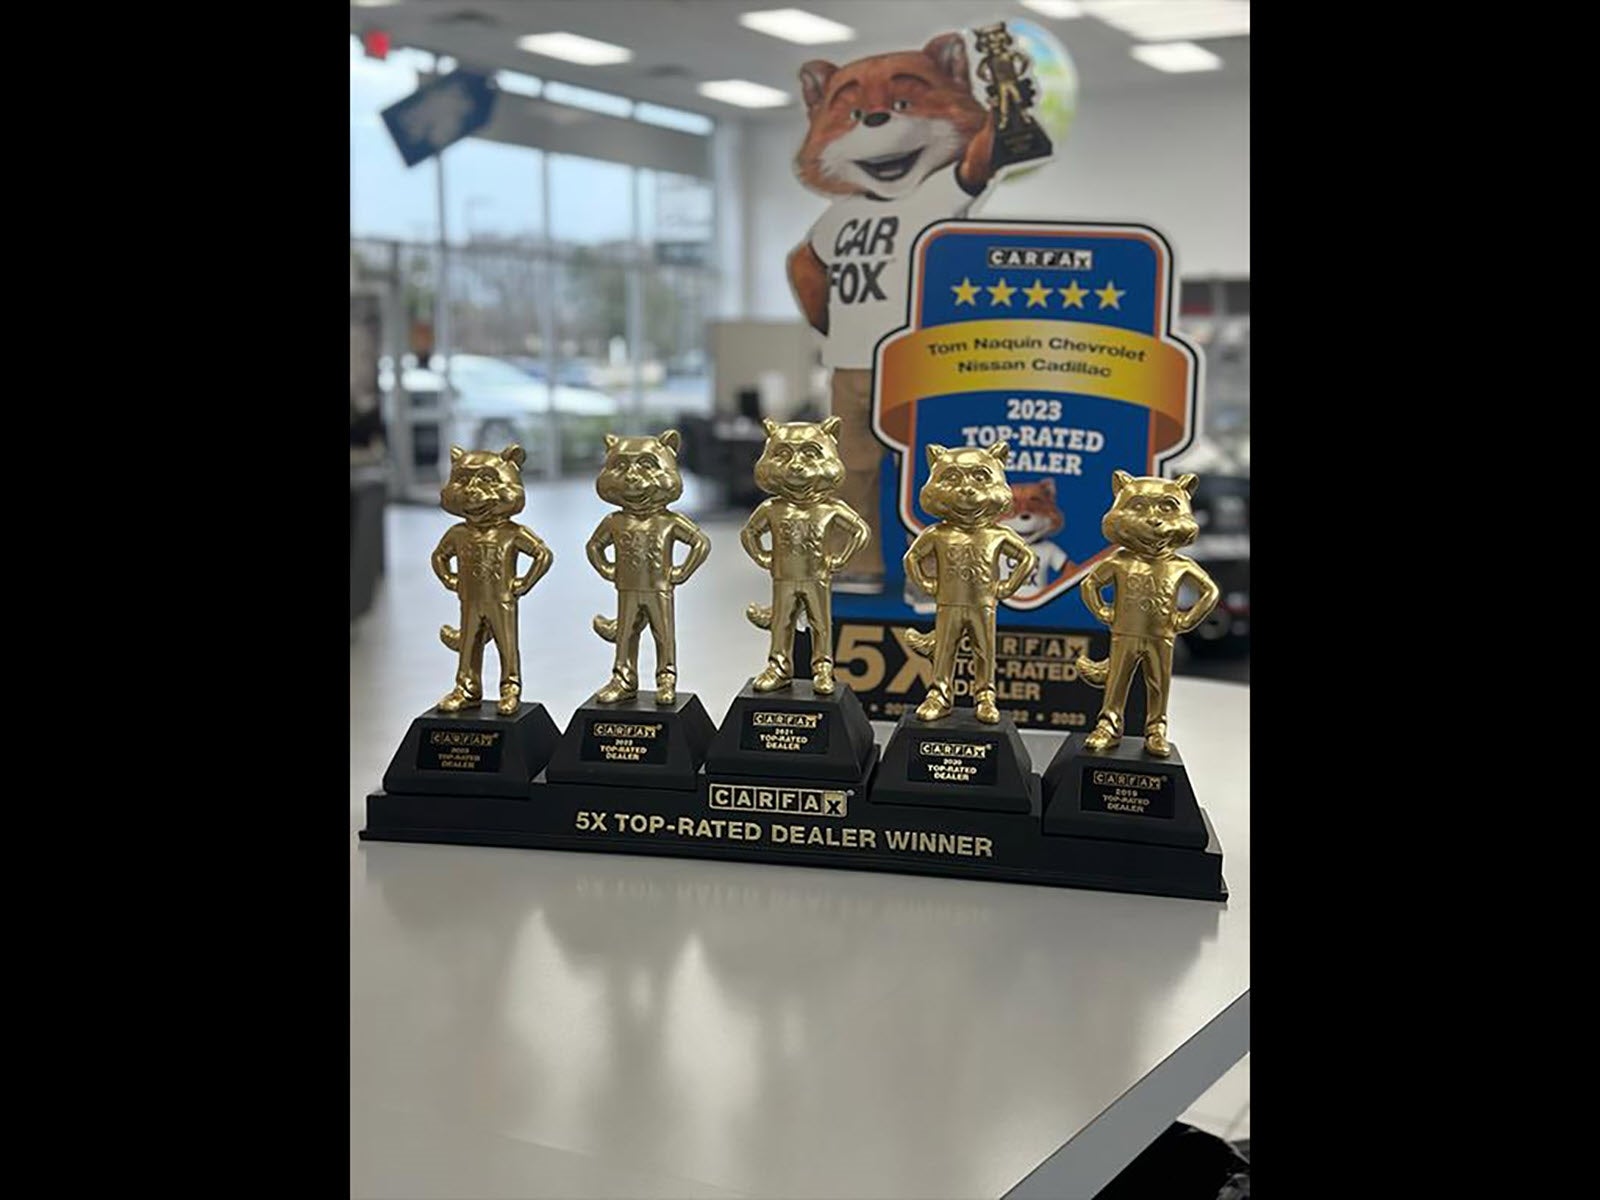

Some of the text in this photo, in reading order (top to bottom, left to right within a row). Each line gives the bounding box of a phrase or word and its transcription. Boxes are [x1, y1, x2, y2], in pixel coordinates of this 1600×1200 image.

[834, 216, 899, 256] CAR
[989, 247, 1092, 270] CARFAX
[831, 261, 887, 304] FOX
[928, 336, 1146, 362] Tom Naquin Chevrolet
[958, 358, 1111, 377] Nissan Cadillac
[1007, 398, 1062, 421] 2023
[962, 425, 1104, 452] TOP-RATED
[1004, 451, 1082, 475] EALER
[753, 712, 816, 728] CARFAX
[594, 723, 656, 738] CARFAX
[760, 734, 808, 744] TOP-RATED
[600, 745, 647, 754] TOP-RATED
[766, 742, 800, 750] DEALER
[920, 742, 985, 758] CARFAX
[606, 752, 640, 760] DEALER
[927, 764, 977, 774] TOP-RATED
[934, 772, 969, 781] DEALER
[1093, 771, 1161, 790] CARFAX
[710, 785, 846, 817] CARFAX
[1102, 794, 1150, 806] TOP-RATED
[1107, 803, 1144, 813] DEALER
[575, 811, 993, 857] 5X TOP-RATED DEALER WINNER
